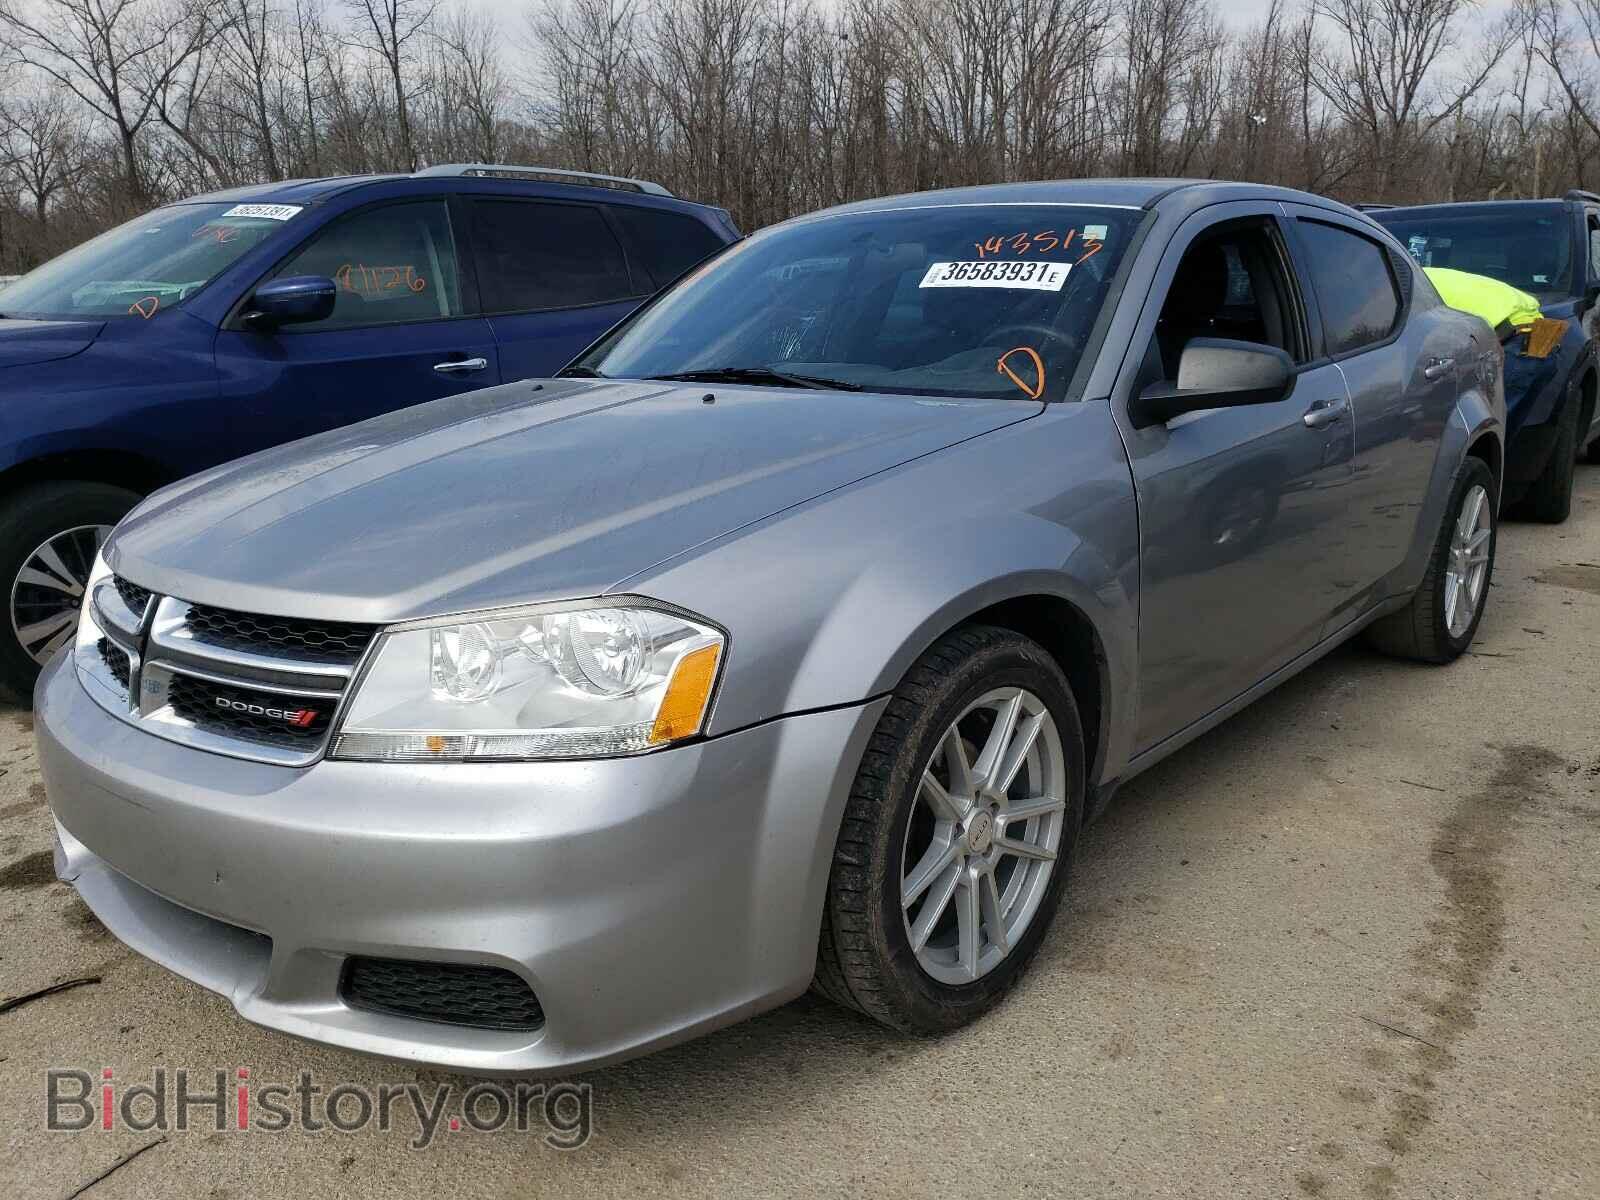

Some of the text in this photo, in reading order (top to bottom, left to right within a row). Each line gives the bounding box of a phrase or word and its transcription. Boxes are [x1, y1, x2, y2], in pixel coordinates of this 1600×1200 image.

[941, 262, 1050, 283] 36583931
[1048, 271, 1060, 283] E
[997, 347, 1045, 399] D
[215, 697, 301, 722] DODGE
